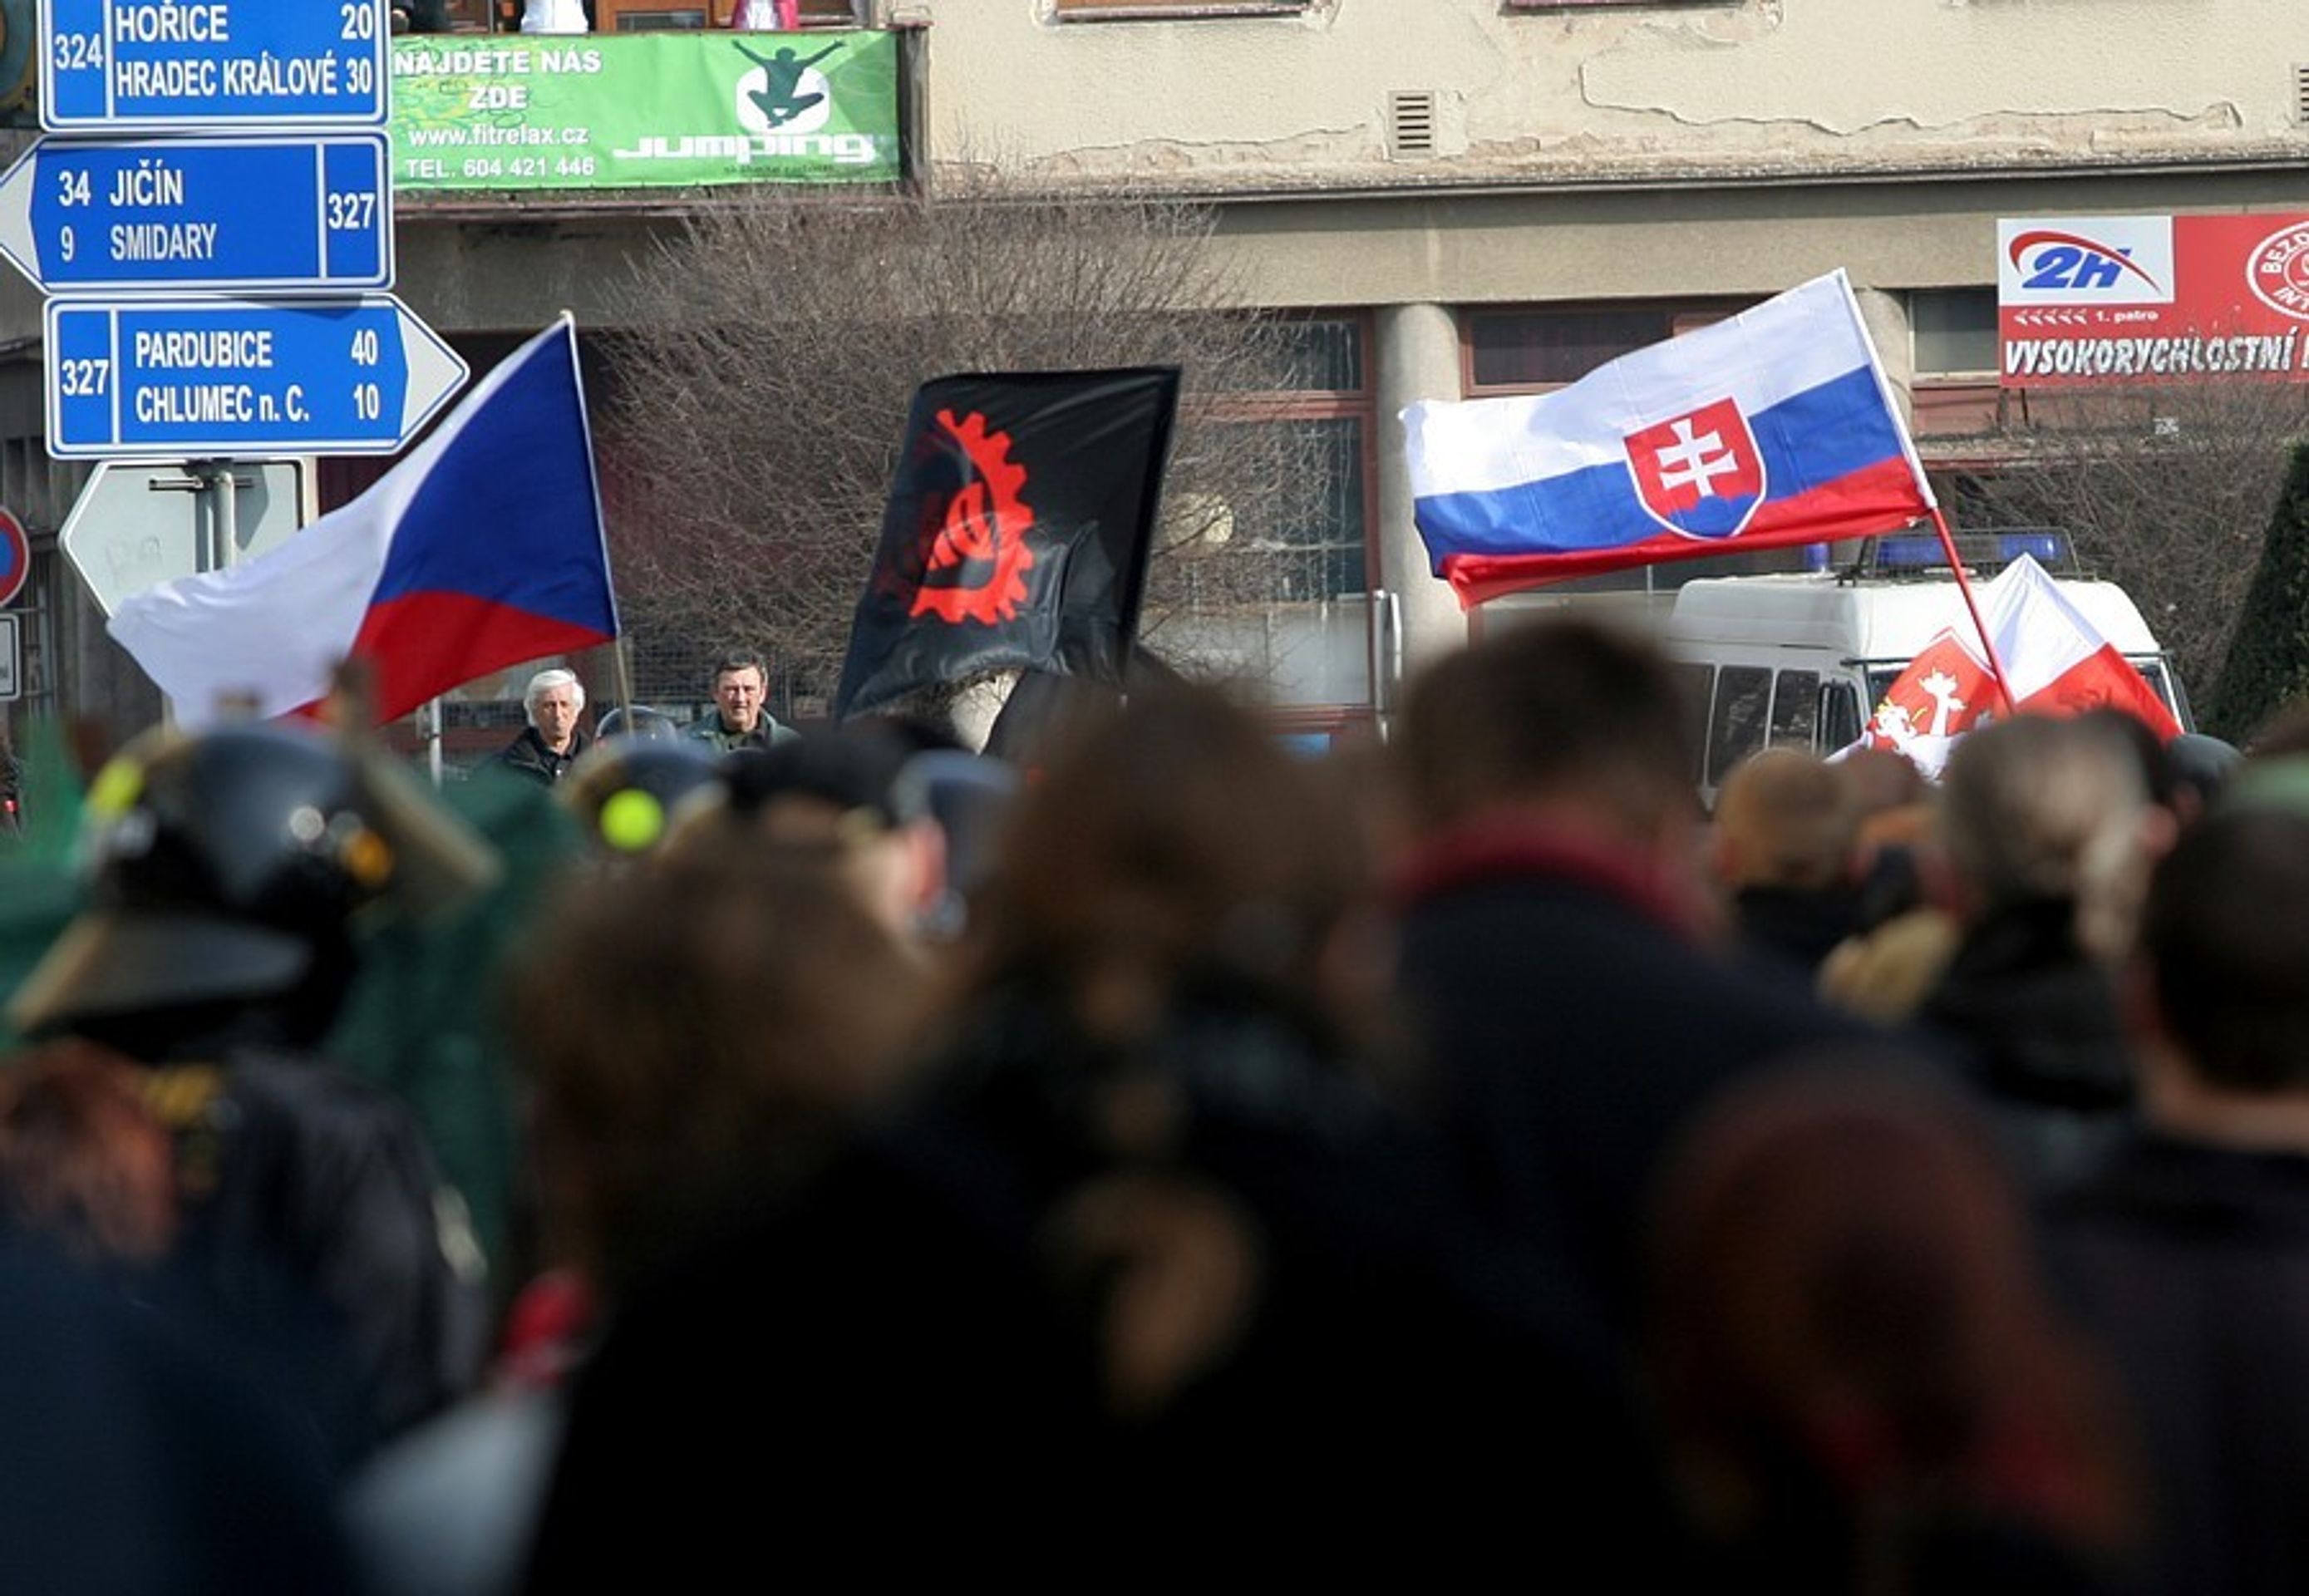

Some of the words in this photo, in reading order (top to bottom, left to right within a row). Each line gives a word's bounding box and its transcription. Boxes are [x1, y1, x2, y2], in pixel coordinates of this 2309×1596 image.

[115, 0, 229, 42] HOŘICE
[341, 3, 372, 40] 20
[54, 34, 103, 70] 324
[395, 51, 530, 74] NAJDETE
[540, 45, 601, 73] NÁS
[116, 58, 216, 96] HRADEC
[223, 49, 337, 96] KRÁLOVÉ
[346, 58, 372, 93] 30
[469, 86, 527, 110] ZDE
[409, 126, 588, 145] www.fitrelax.cz
[58, 171, 91, 206] 34
[110, 160, 183, 206] JIČÍN
[405, 159, 455, 178] TEL.
[463, 159, 502, 177] 604
[510, 158, 546, 176] 421
[554, 157, 594, 175] 446
[327, 194, 376, 229] 327
[61, 227, 74, 261] 9
[110, 224, 216, 260] SMIDARY
[2021, 246, 2133, 288] 2H
[2095, 311, 2110, 323] 1.
[2114, 310, 2159, 324] patro
[135, 331, 273, 368] PARDUBICE
[351, 330, 378, 366] 40
[2005, 325, 2299, 376] VYSOKORYCHLOSTNÍ
[62, 360, 109, 396] 327
[135, 387, 253, 422] CHLUMEC
[258, 389, 280, 421] n.
[286, 387, 309, 421] C.
[353, 385, 379, 420] 10
